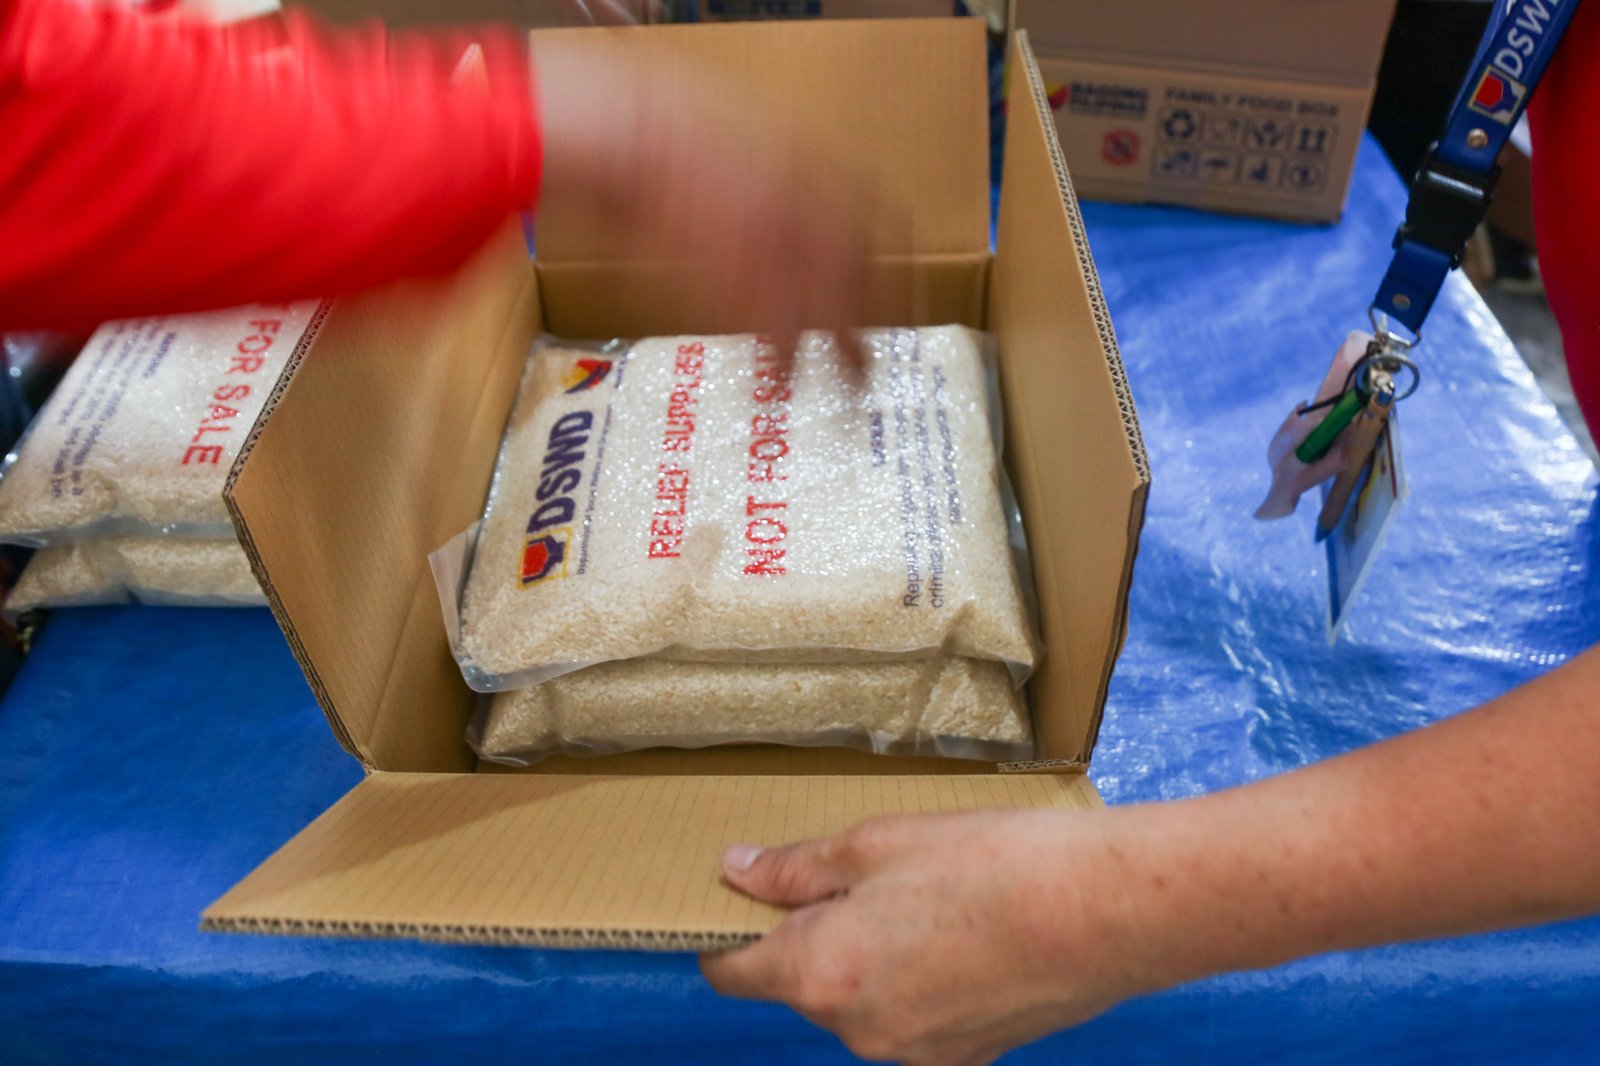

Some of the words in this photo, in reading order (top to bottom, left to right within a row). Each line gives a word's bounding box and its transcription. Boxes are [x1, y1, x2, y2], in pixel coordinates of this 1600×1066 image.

[1494, 0, 1560, 79] DSW
[1165, 87, 1231, 105] FAMILY
[1237, 96, 1292, 112] FOOD
[1298, 103, 1340, 117] BOX
[225, 319, 282, 374] FOR
[181, 383, 251, 465] SALE
[662, 341, 705, 452] SUPPLIES
[526, 410, 593, 533] DSWD
[747, 413, 791, 482] FOR
[648, 461, 690, 559] RELIEF
[743, 496, 789, 576] NOT
